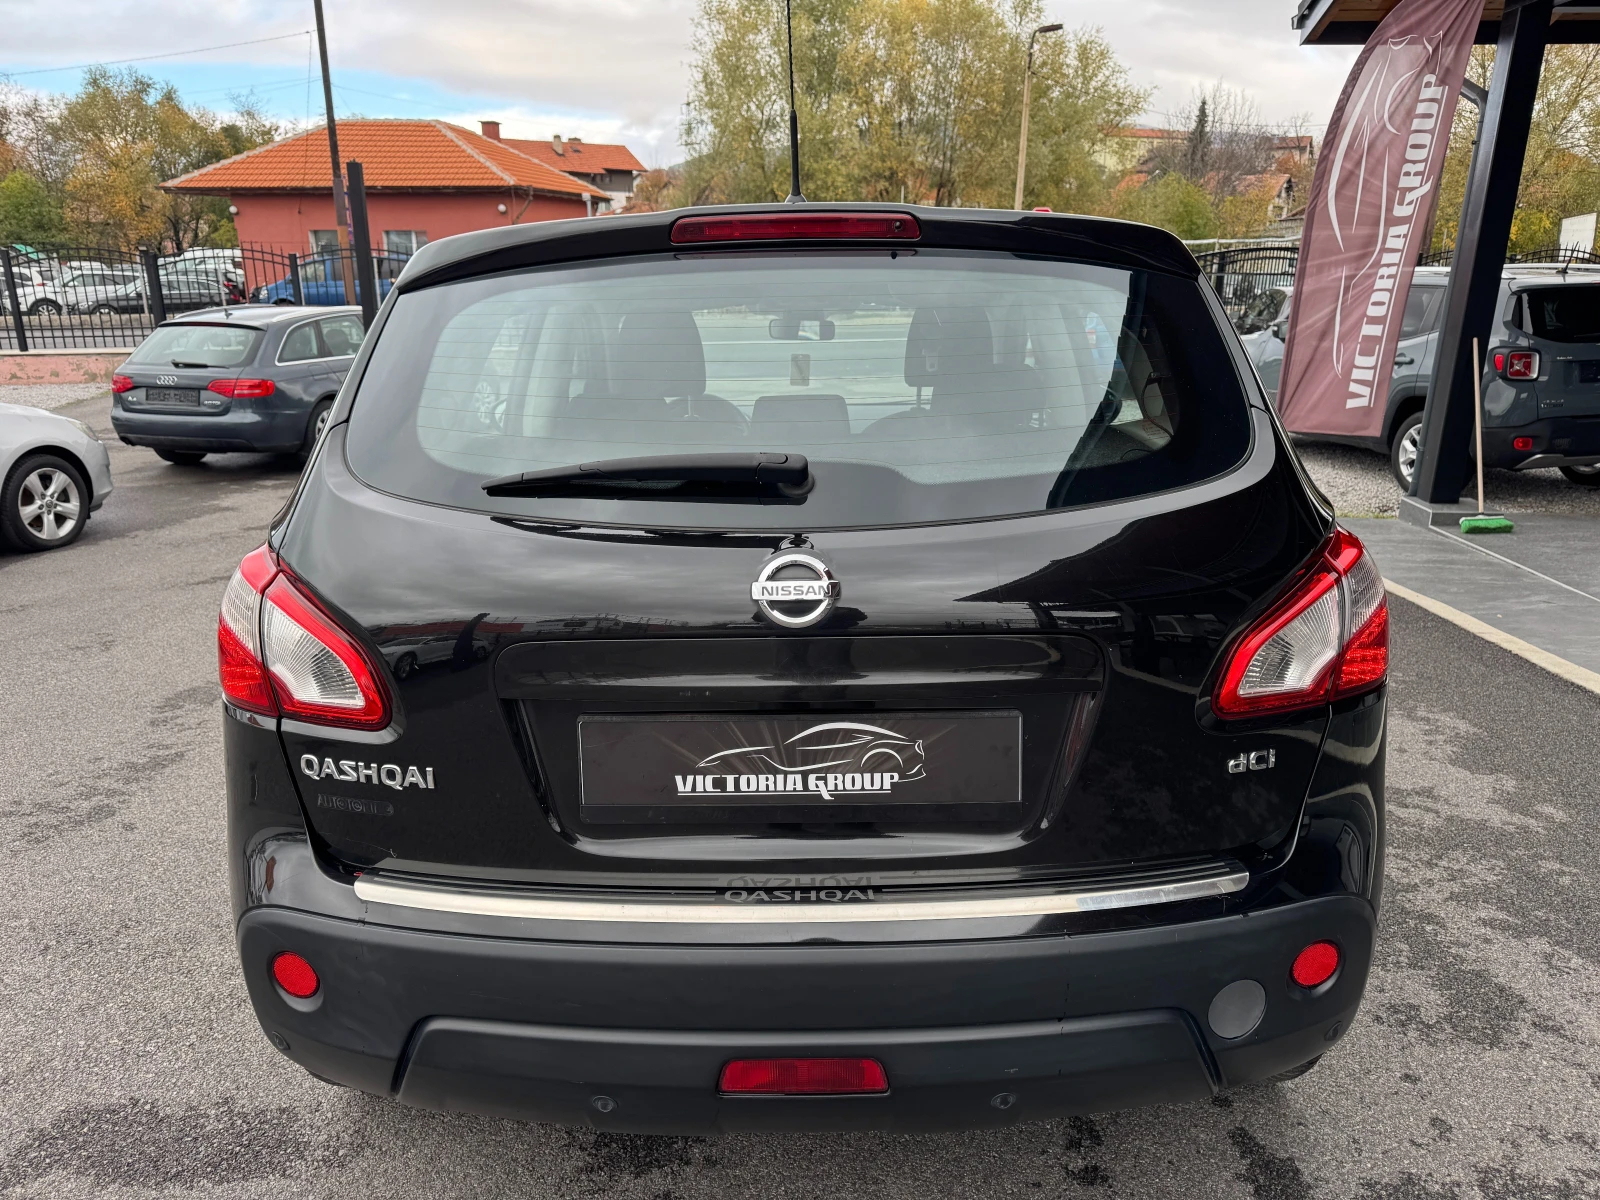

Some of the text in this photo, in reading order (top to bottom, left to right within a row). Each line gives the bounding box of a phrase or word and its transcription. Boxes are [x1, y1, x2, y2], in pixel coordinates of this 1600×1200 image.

[1345, 72, 1440, 410] VICTORIA GROUP
[761, 584, 832, 597] NISSAN
[300, 753, 435, 791] QASHQAI
[674, 772, 900, 800] VICTORIA GROUP
[724, 888, 876, 903] QASHQAI
